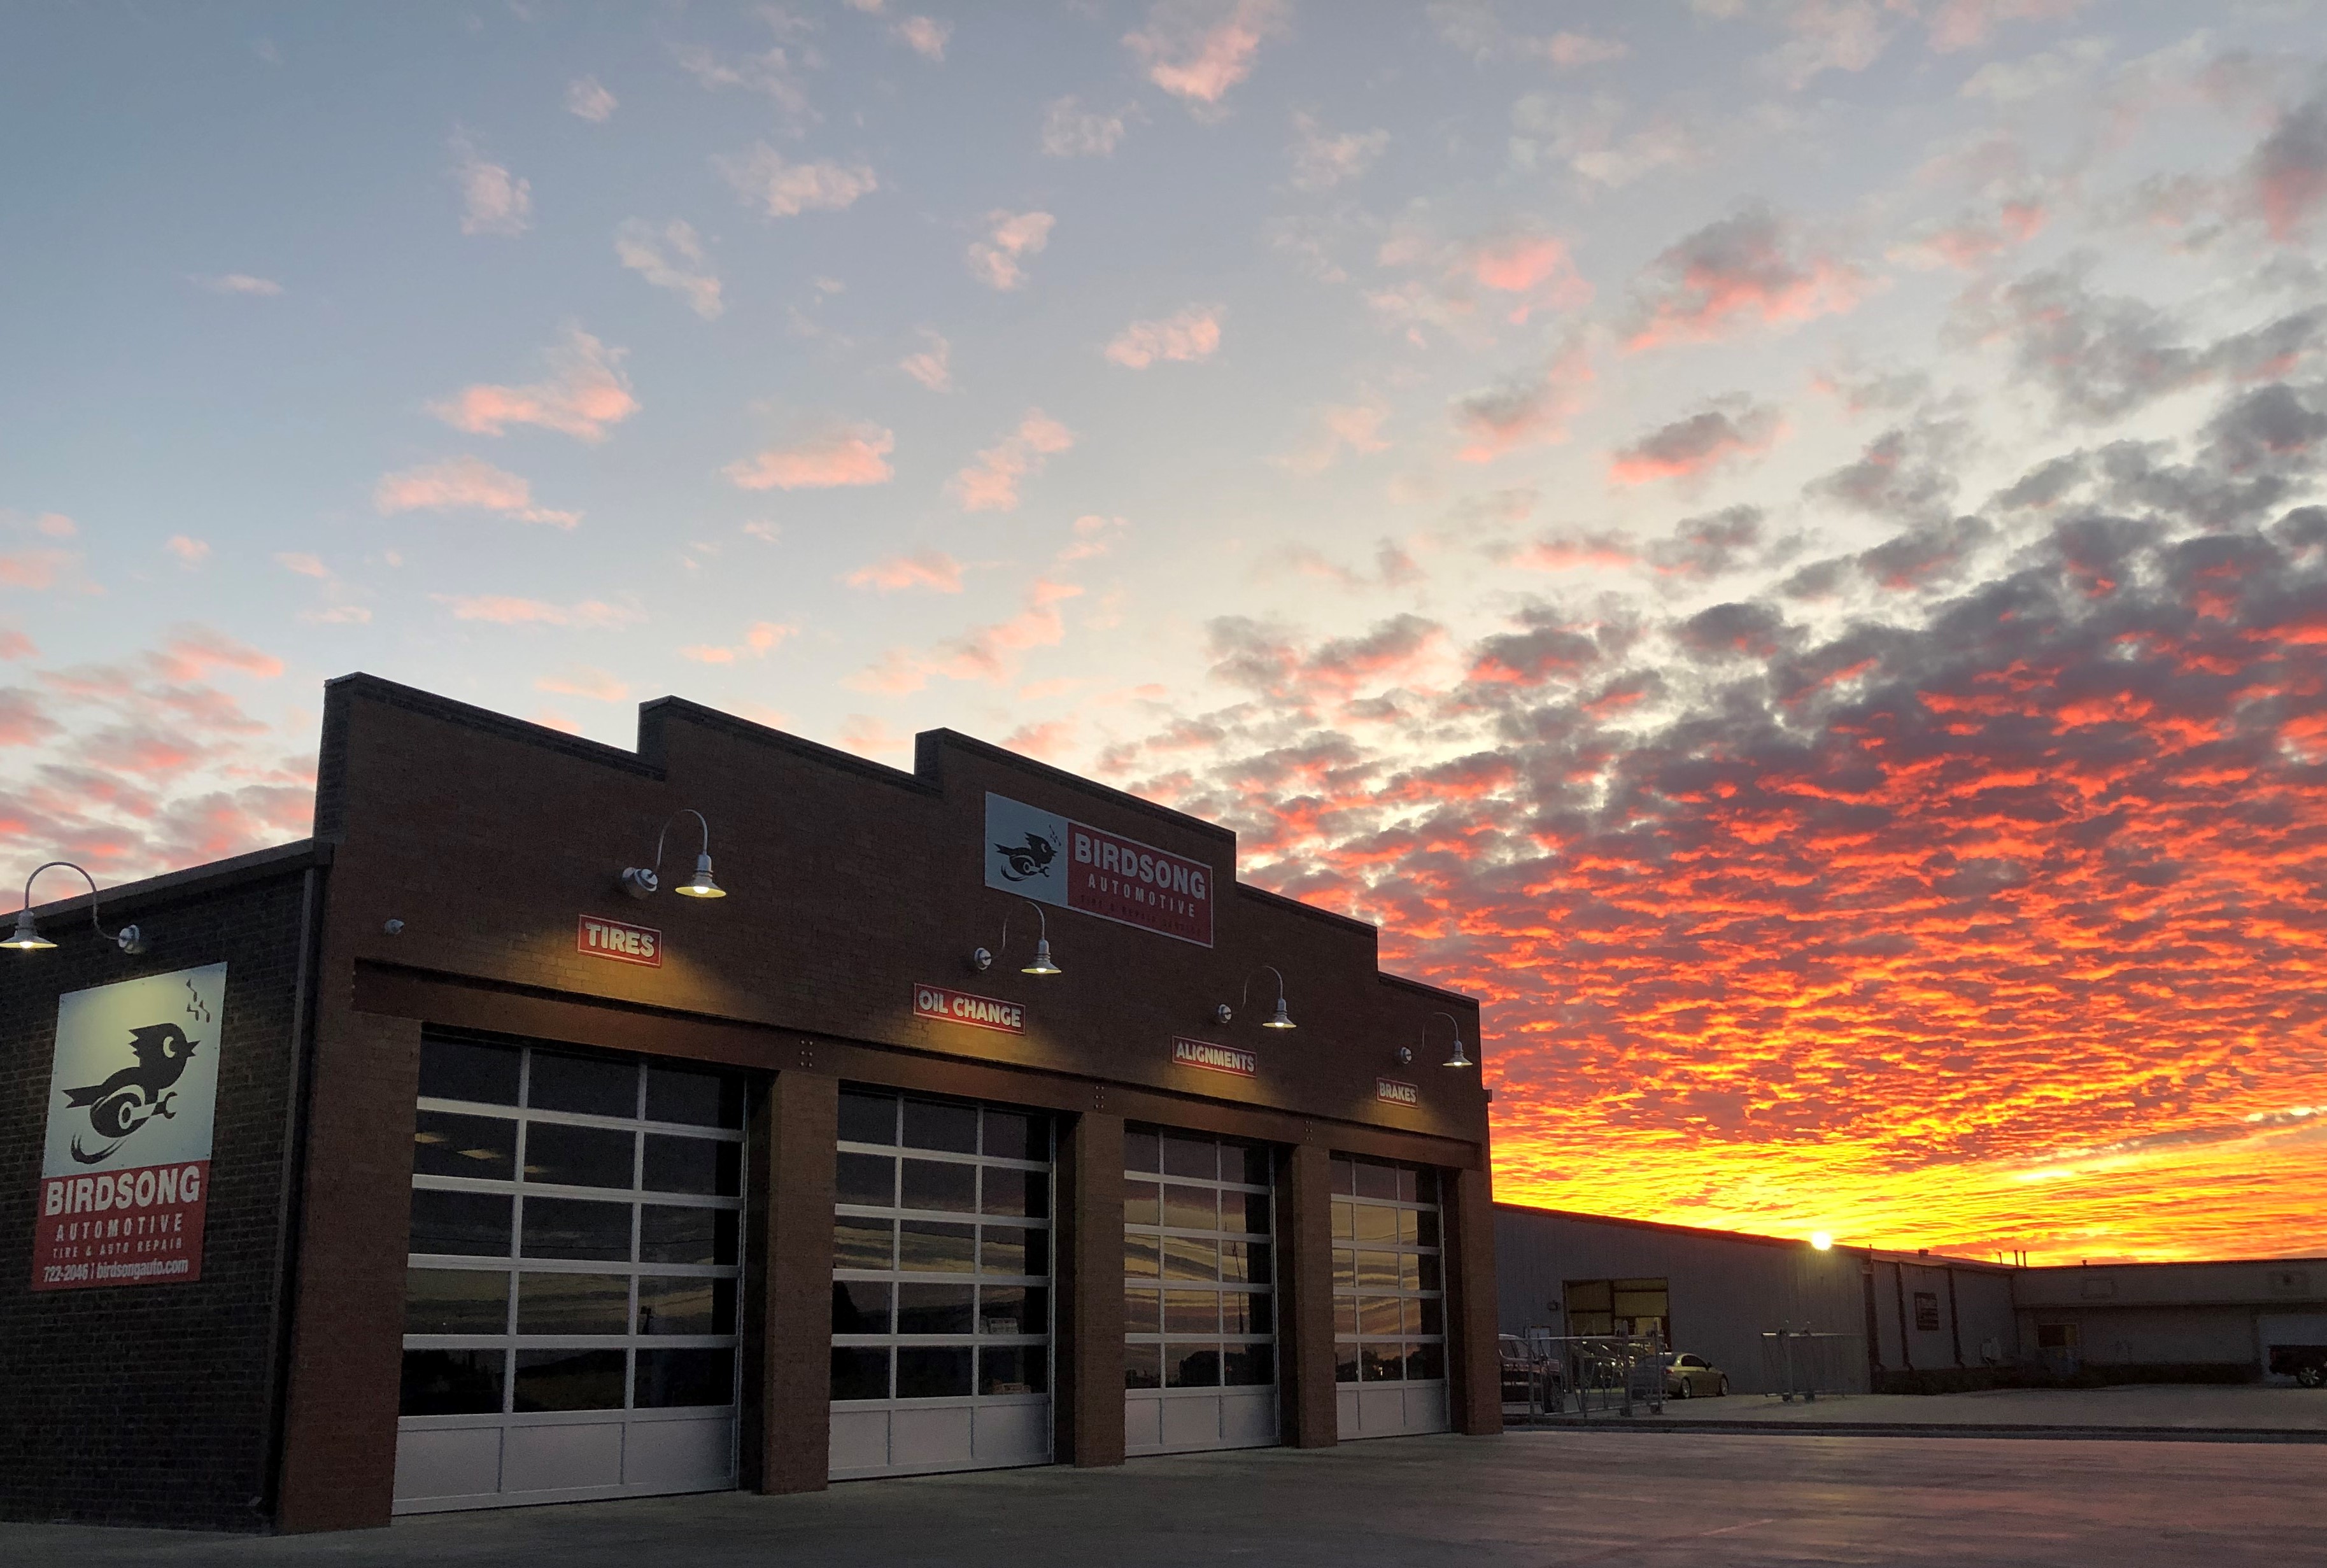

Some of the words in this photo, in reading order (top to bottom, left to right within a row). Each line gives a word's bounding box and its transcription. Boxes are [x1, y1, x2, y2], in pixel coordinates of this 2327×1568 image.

[1075, 833, 1206, 900] BIRDSONG
[1088, 873, 1195, 917] AUTOMOTIVE
[585, 921, 654, 957] TIRES
[918, 989, 949, 1014] OIL
[952, 996, 1021, 1028] CHANGE
[1176, 1040, 1254, 1072] ALIGNMENTS
[1378, 1082, 1417, 1103] BRAKES
[45, 1166, 201, 1217] BIRDSONG
[55, 1213, 183, 1242] AUTOMOTIVE
[53, 1247, 78, 1259] TIRE
[99, 1242, 129, 1256] AUTO
[137, 1238, 182, 1252] REPAIR
[97, 1258, 189, 1281] birdsongauto.com
